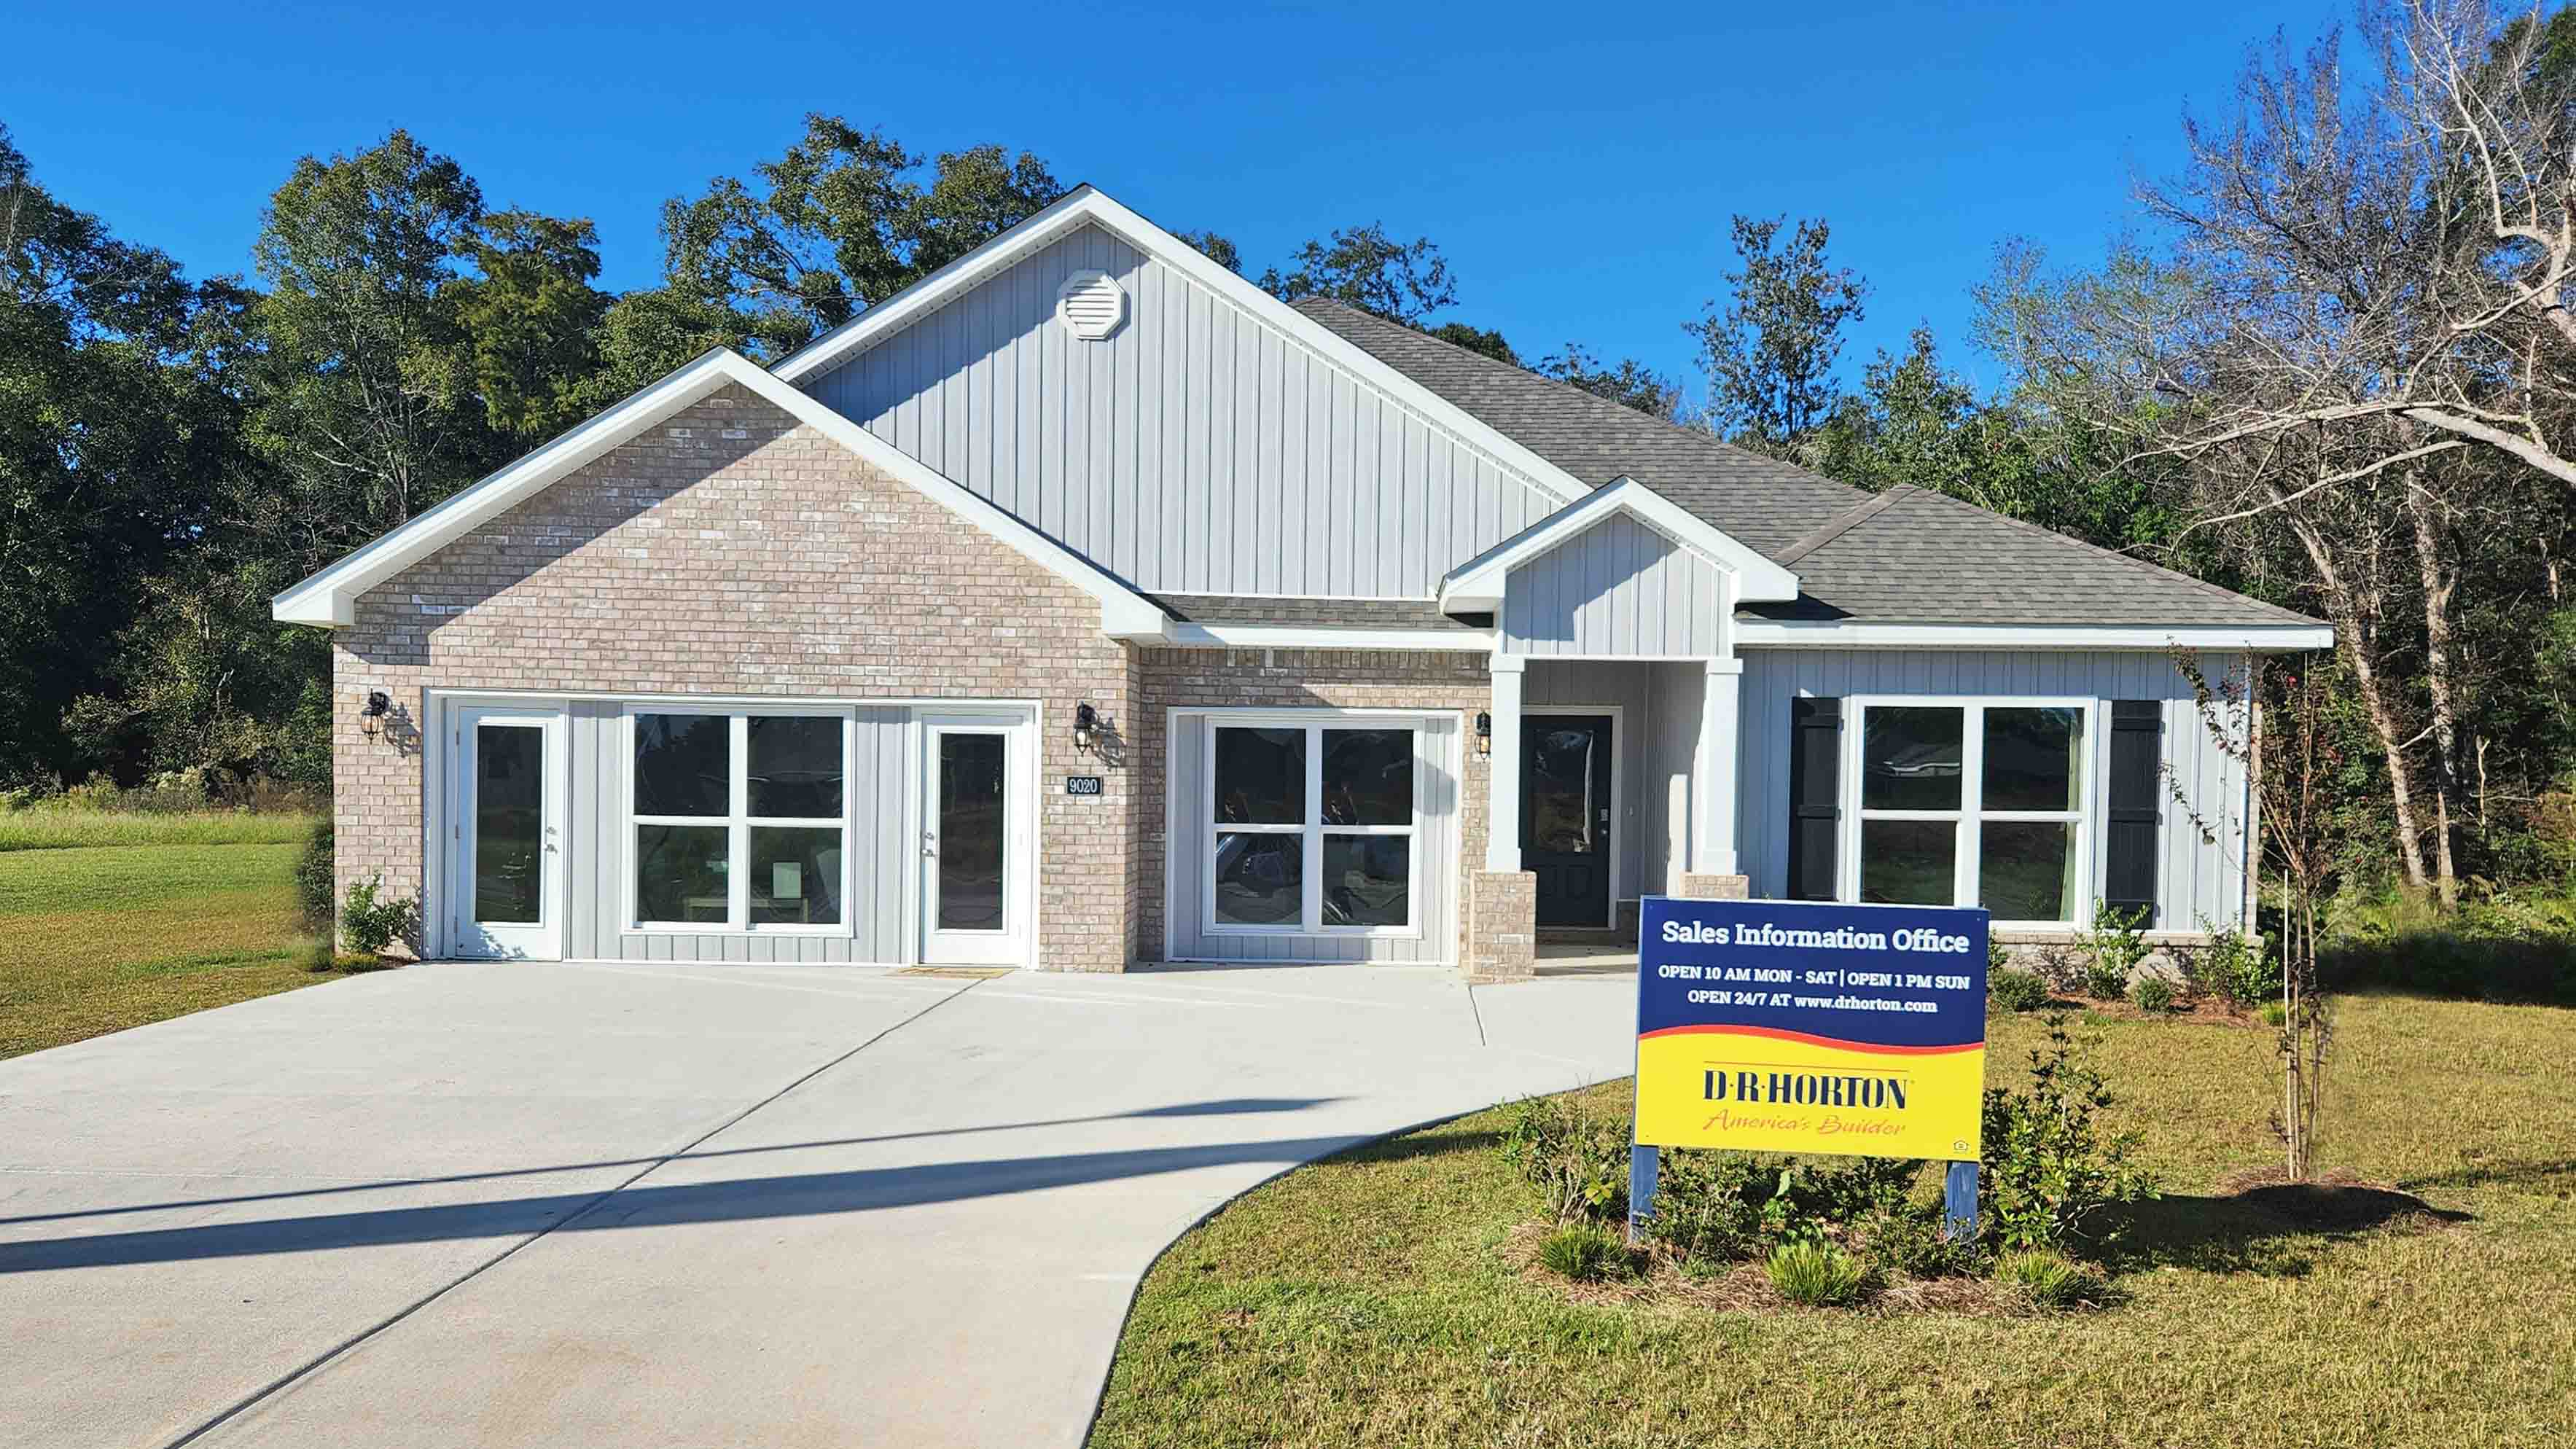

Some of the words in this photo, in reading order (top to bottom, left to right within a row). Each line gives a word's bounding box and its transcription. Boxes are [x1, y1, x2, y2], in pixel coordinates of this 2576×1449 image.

[1069, 778, 1097, 792] 9020
[1662, 921, 1729, 944] Sales
[1735, 923, 1886, 949] Information
[1892, 929, 1970, 953] Office
[1658, 965, 1701, 979] OPEN
[1705, 967, 1722, 980] 10
[1724, 968, 1750, 981] AM
[1754, 969, 1792, 983] MON
[1806, 971, 1836, 984] SAT
[1847, 972, 1892, 987] OPEN
[1895, 975, 1903, 986] 1
[1906, 975, 1932, 988] PM
[1935, 975, 1970, 989] SUN
[1688, 990, 1731, 1004] OPEN
[1735, 991, 1766, 1006] 24/7
[1769, 993, 1791, 1006] AT
[1795, 996, 1937, 1012] www.drhorton.com
[1702, 1108, 1810, 1131] America's
[1816, 1115, 1906, 1136] Builder
